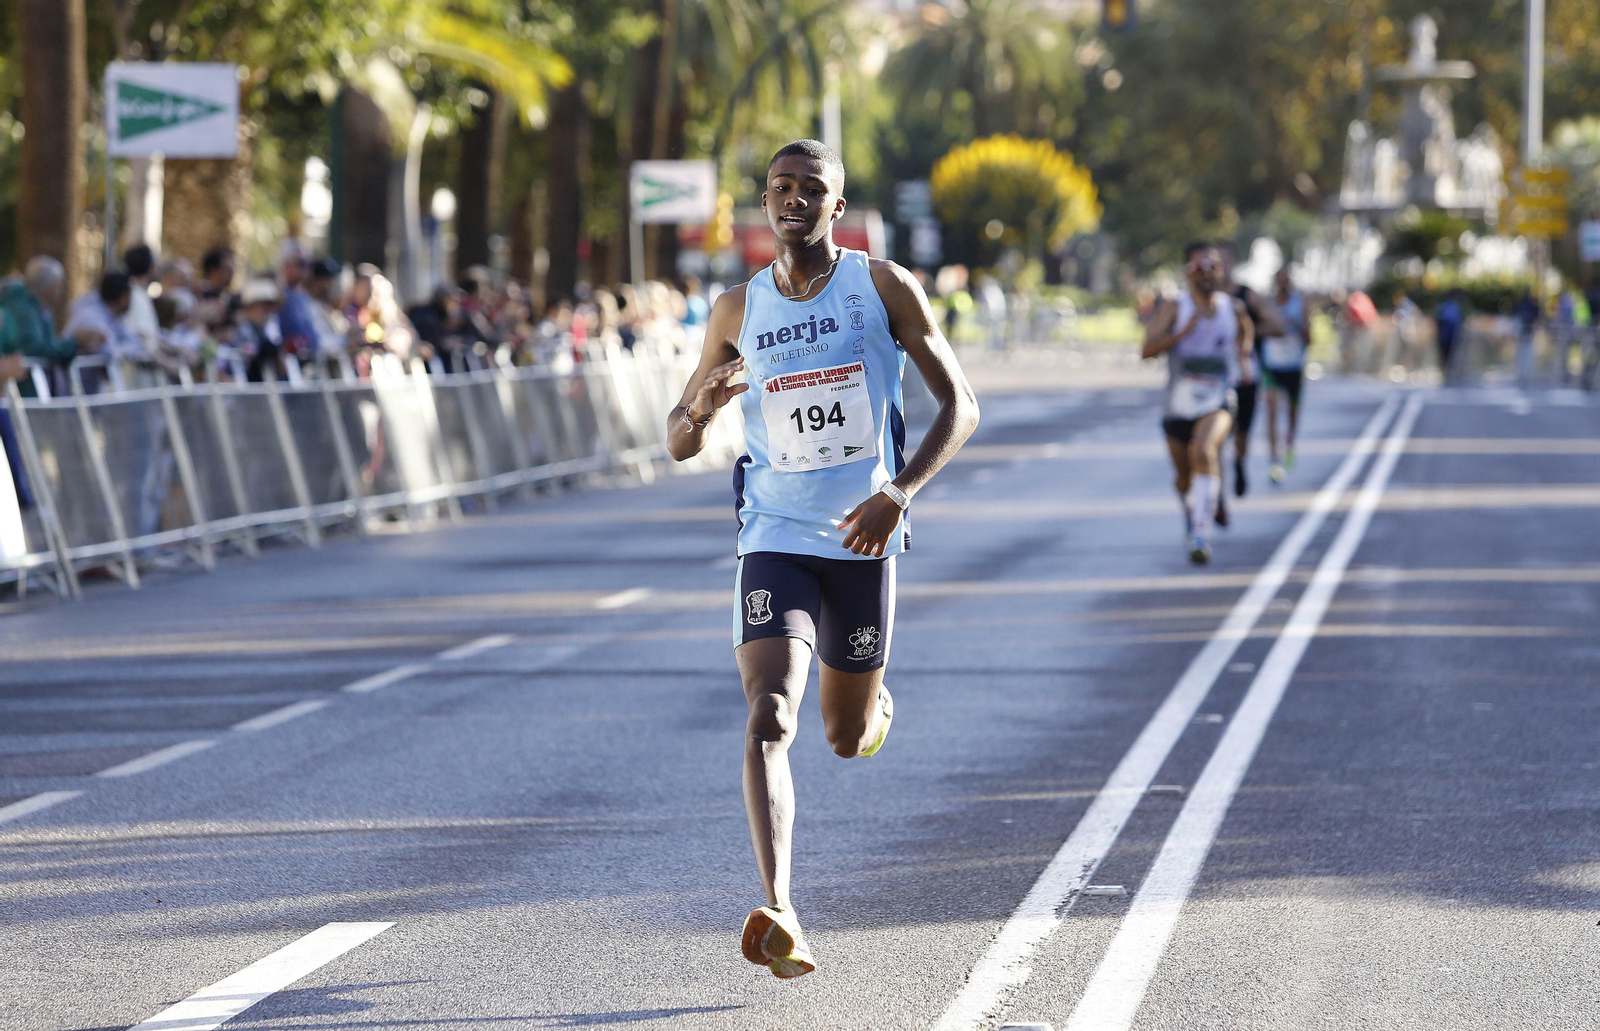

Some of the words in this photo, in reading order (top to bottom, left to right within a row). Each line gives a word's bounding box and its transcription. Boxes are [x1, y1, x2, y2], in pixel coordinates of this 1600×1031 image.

[757, 314, 839, 350] nerja
[770, 342, 829, 364] ATLETISMO
[780, 371, 822, 385] CARRERA
[823, 364, 863, 377] URBANA
[781, 382, 806, 391] CIUDAD
[830, 383, 860, 392] FEDERADO
[790, 401, 846, 434] 194
